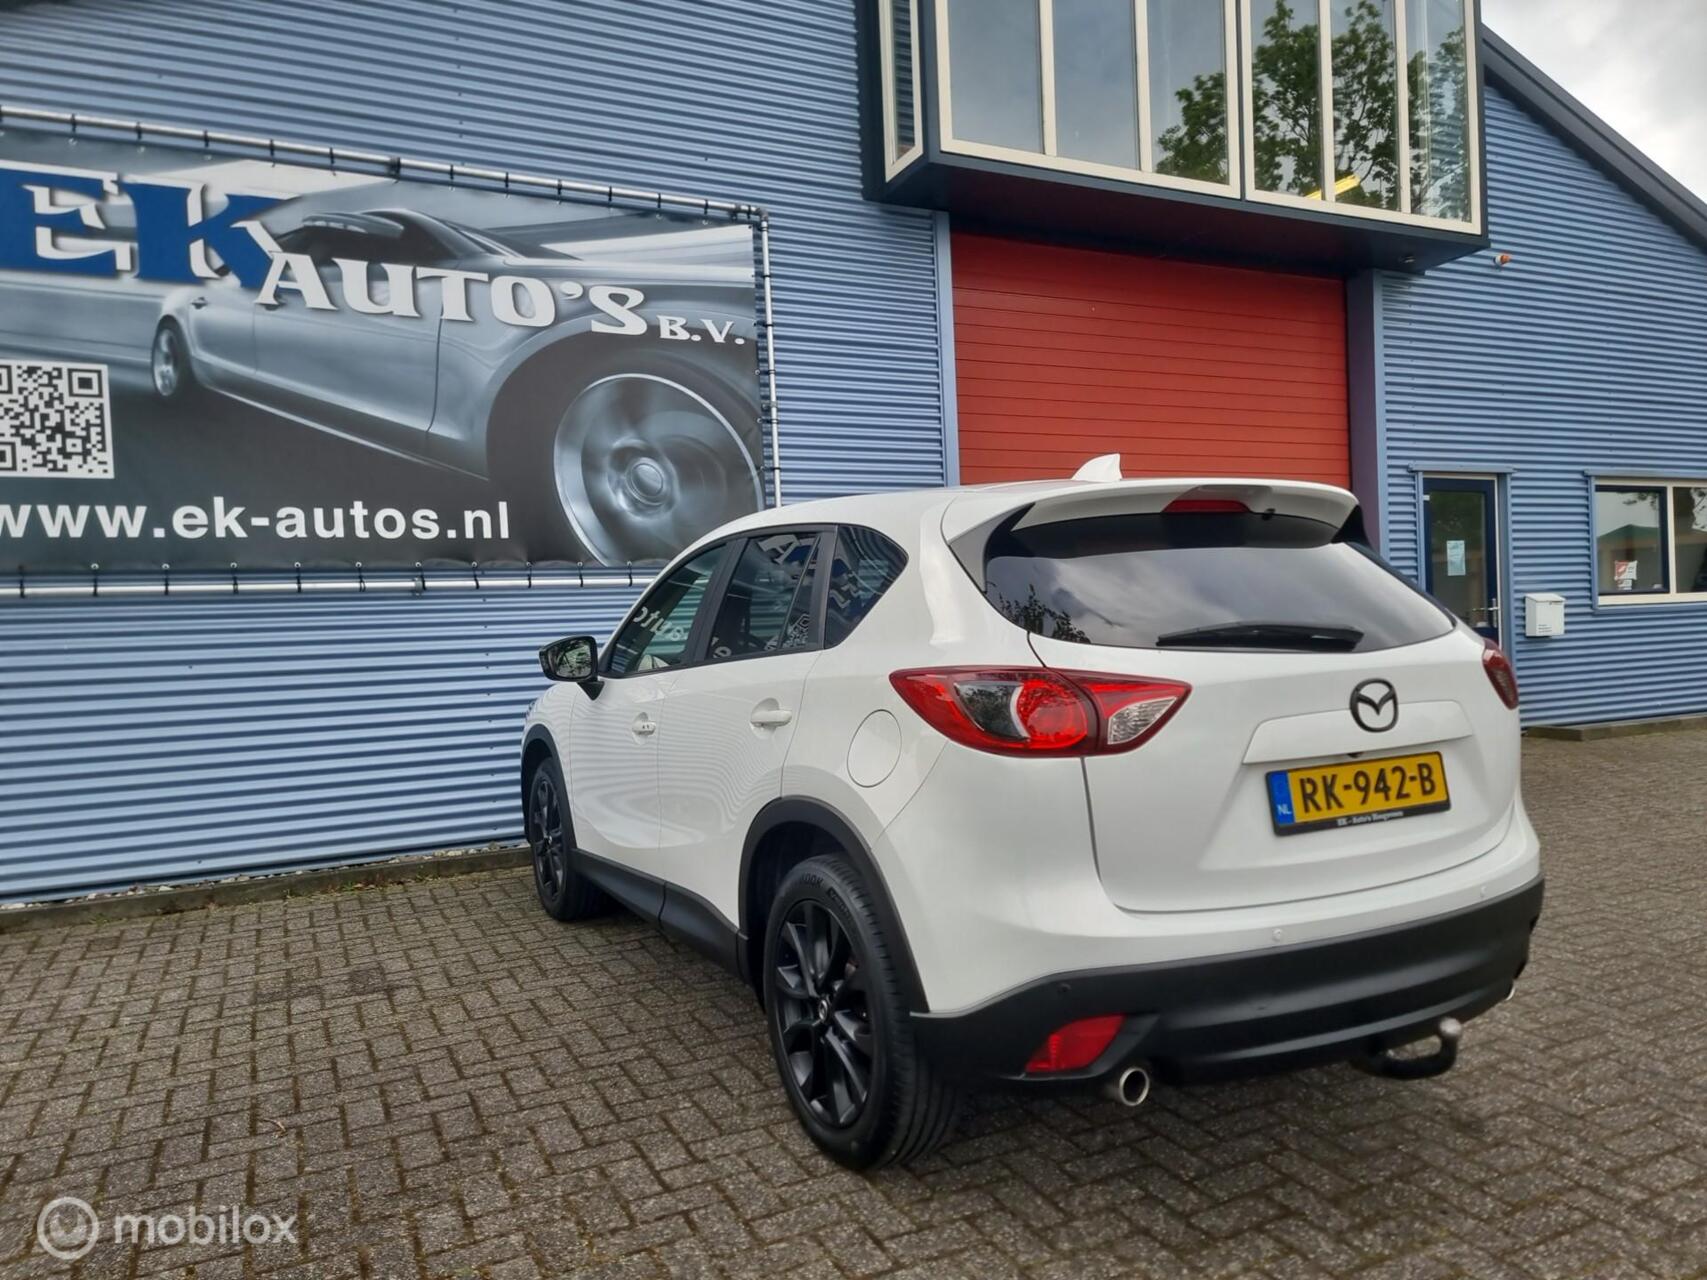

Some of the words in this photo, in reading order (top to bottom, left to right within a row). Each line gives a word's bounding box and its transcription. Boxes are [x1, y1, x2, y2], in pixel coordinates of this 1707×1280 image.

[0, 160, 300, 290] EK
[657, 315, 745, 345] B.V.
[0, 496, 509, 540] www.ek-autos.nl
[1277, 804, 1292, 816] NL
[1299, 762, 1436, 814] RK-942-B
